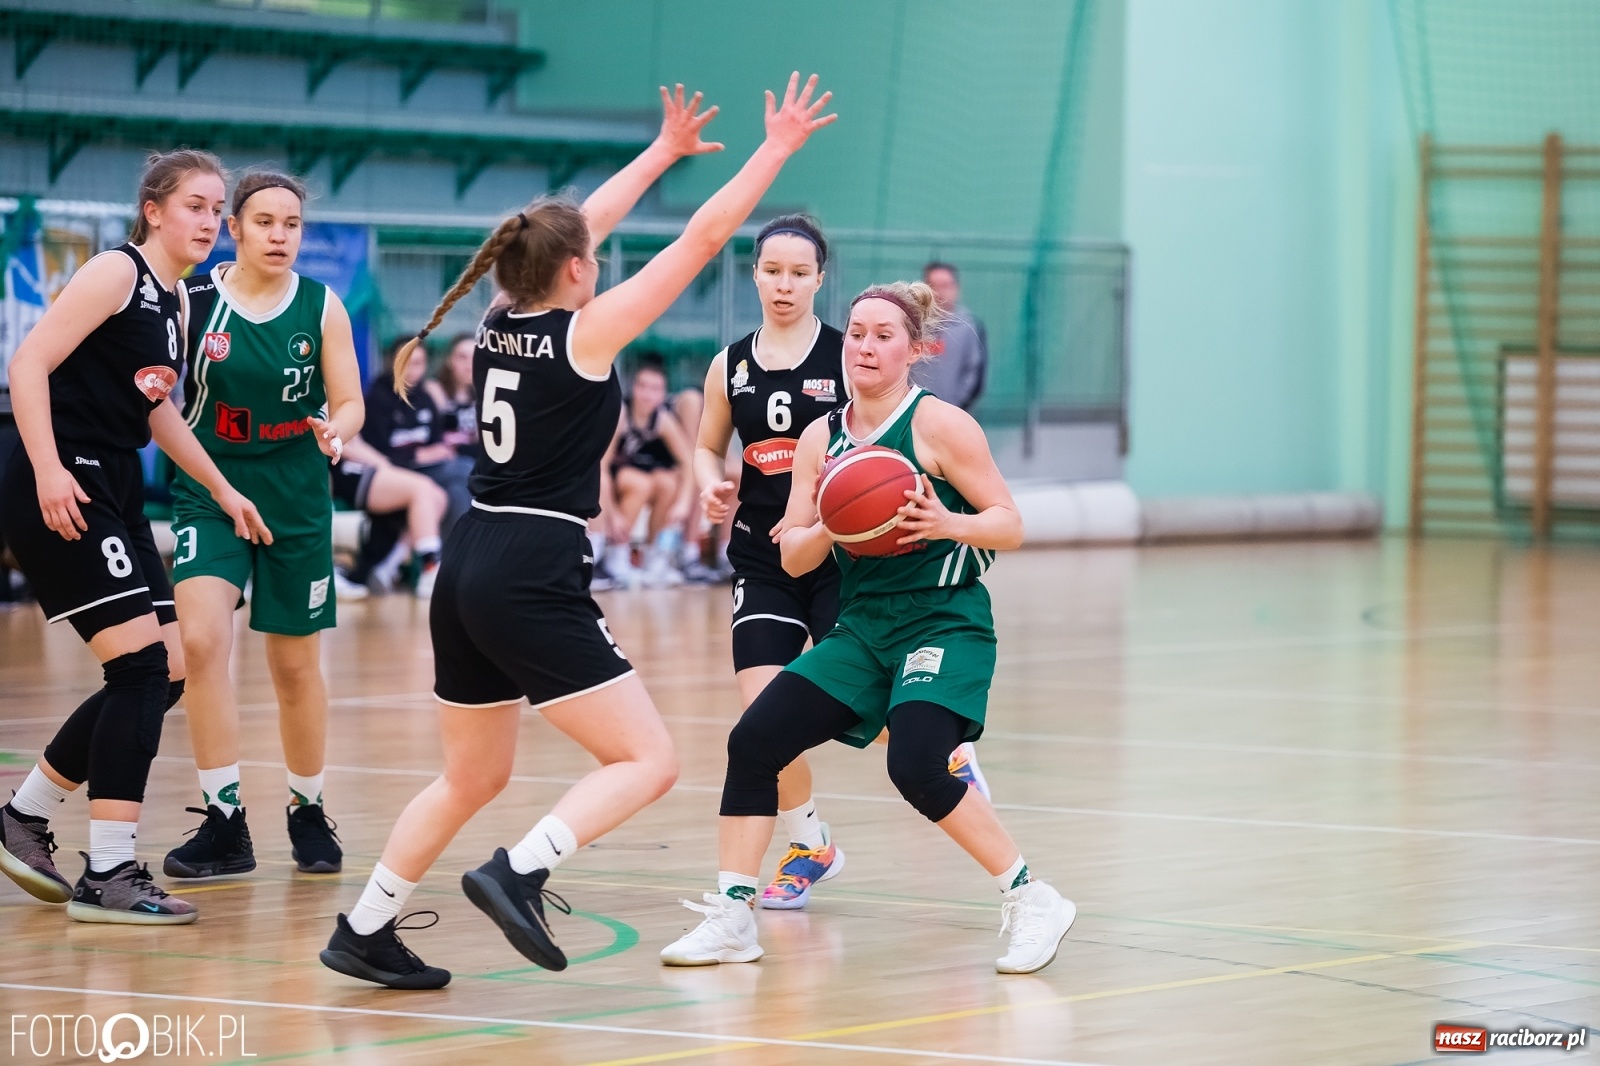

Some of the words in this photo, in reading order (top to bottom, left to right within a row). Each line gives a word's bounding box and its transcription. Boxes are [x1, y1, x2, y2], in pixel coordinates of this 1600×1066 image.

[166, 318, 178, 360] 8
[475, 325, 555, 359] OCHNIA
[282, 365, 315, 402] 23
[481, 367, 521, 464] 5
[767, 390, 792, 432] 6
[75, 456, 101, 468] SPALDIN
[101, 536, 133, 578] 8
